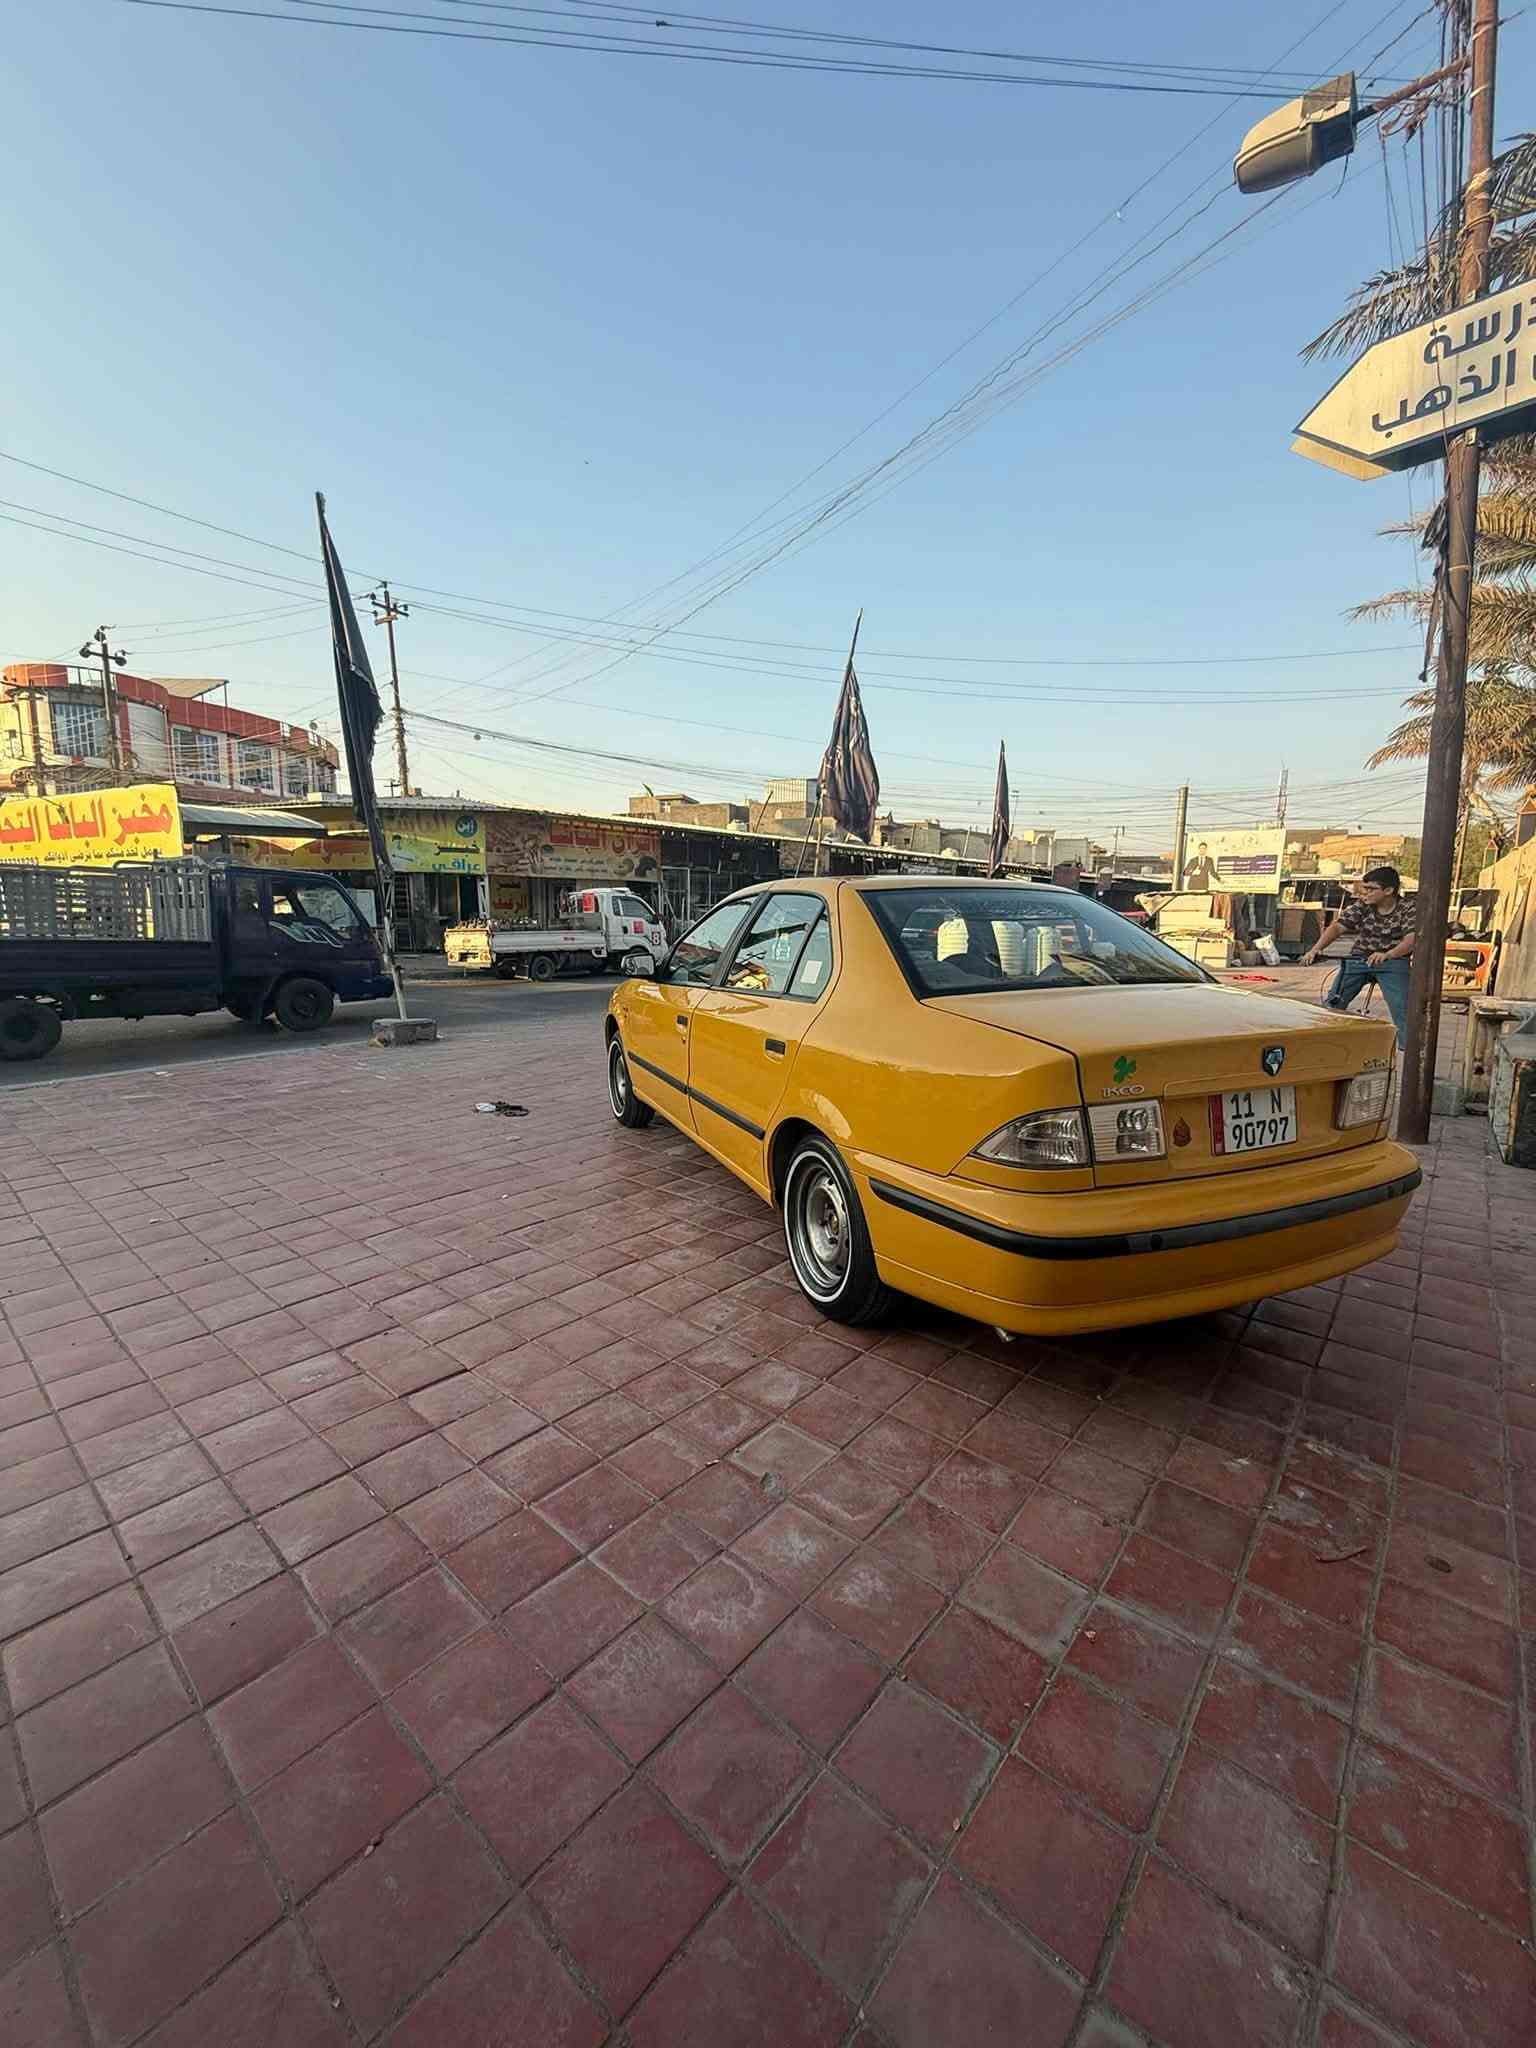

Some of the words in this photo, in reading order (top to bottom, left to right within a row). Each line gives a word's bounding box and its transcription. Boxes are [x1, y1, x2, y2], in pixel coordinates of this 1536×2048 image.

[1424, 296, 1536, 364] رسة
[1372, 349, 1516, 439] الذهب
[112, 793, 173, 846] مخبز
[1231, 1093, 1255, 1119] 11
[1271, 1087, 1282, 1113] N
[1232, 1116, 1289, 1149] 90797
